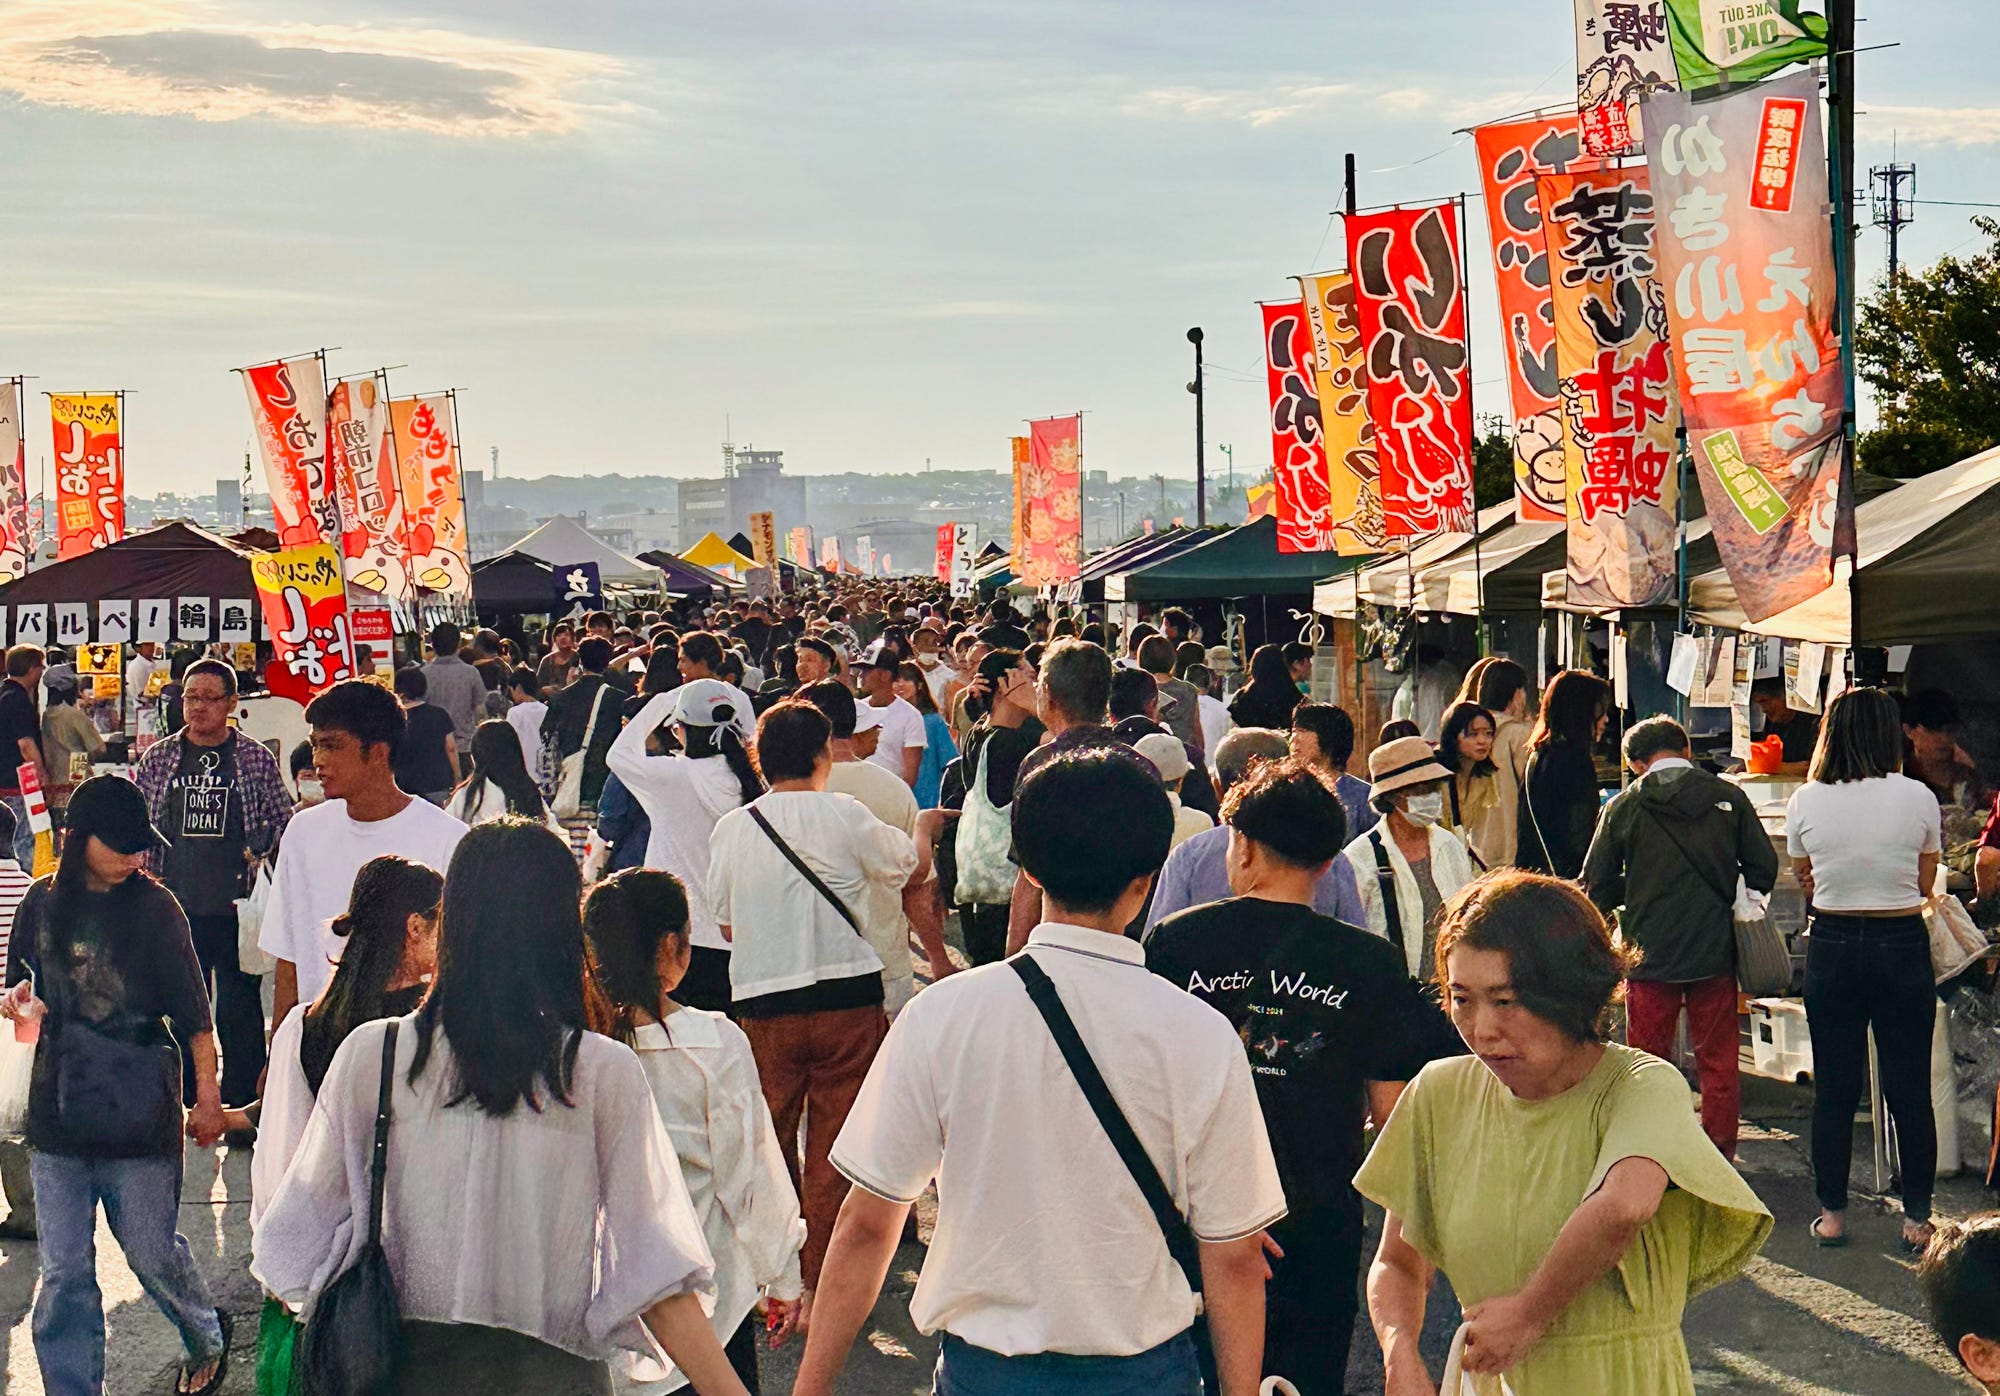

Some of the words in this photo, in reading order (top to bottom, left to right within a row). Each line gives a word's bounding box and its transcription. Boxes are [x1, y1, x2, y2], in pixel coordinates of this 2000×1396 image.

[189, 792, 222, 810] ONE'S
[187, 812, 218, 829] IDEAL
[1270, 969, 1349, 1010] World
